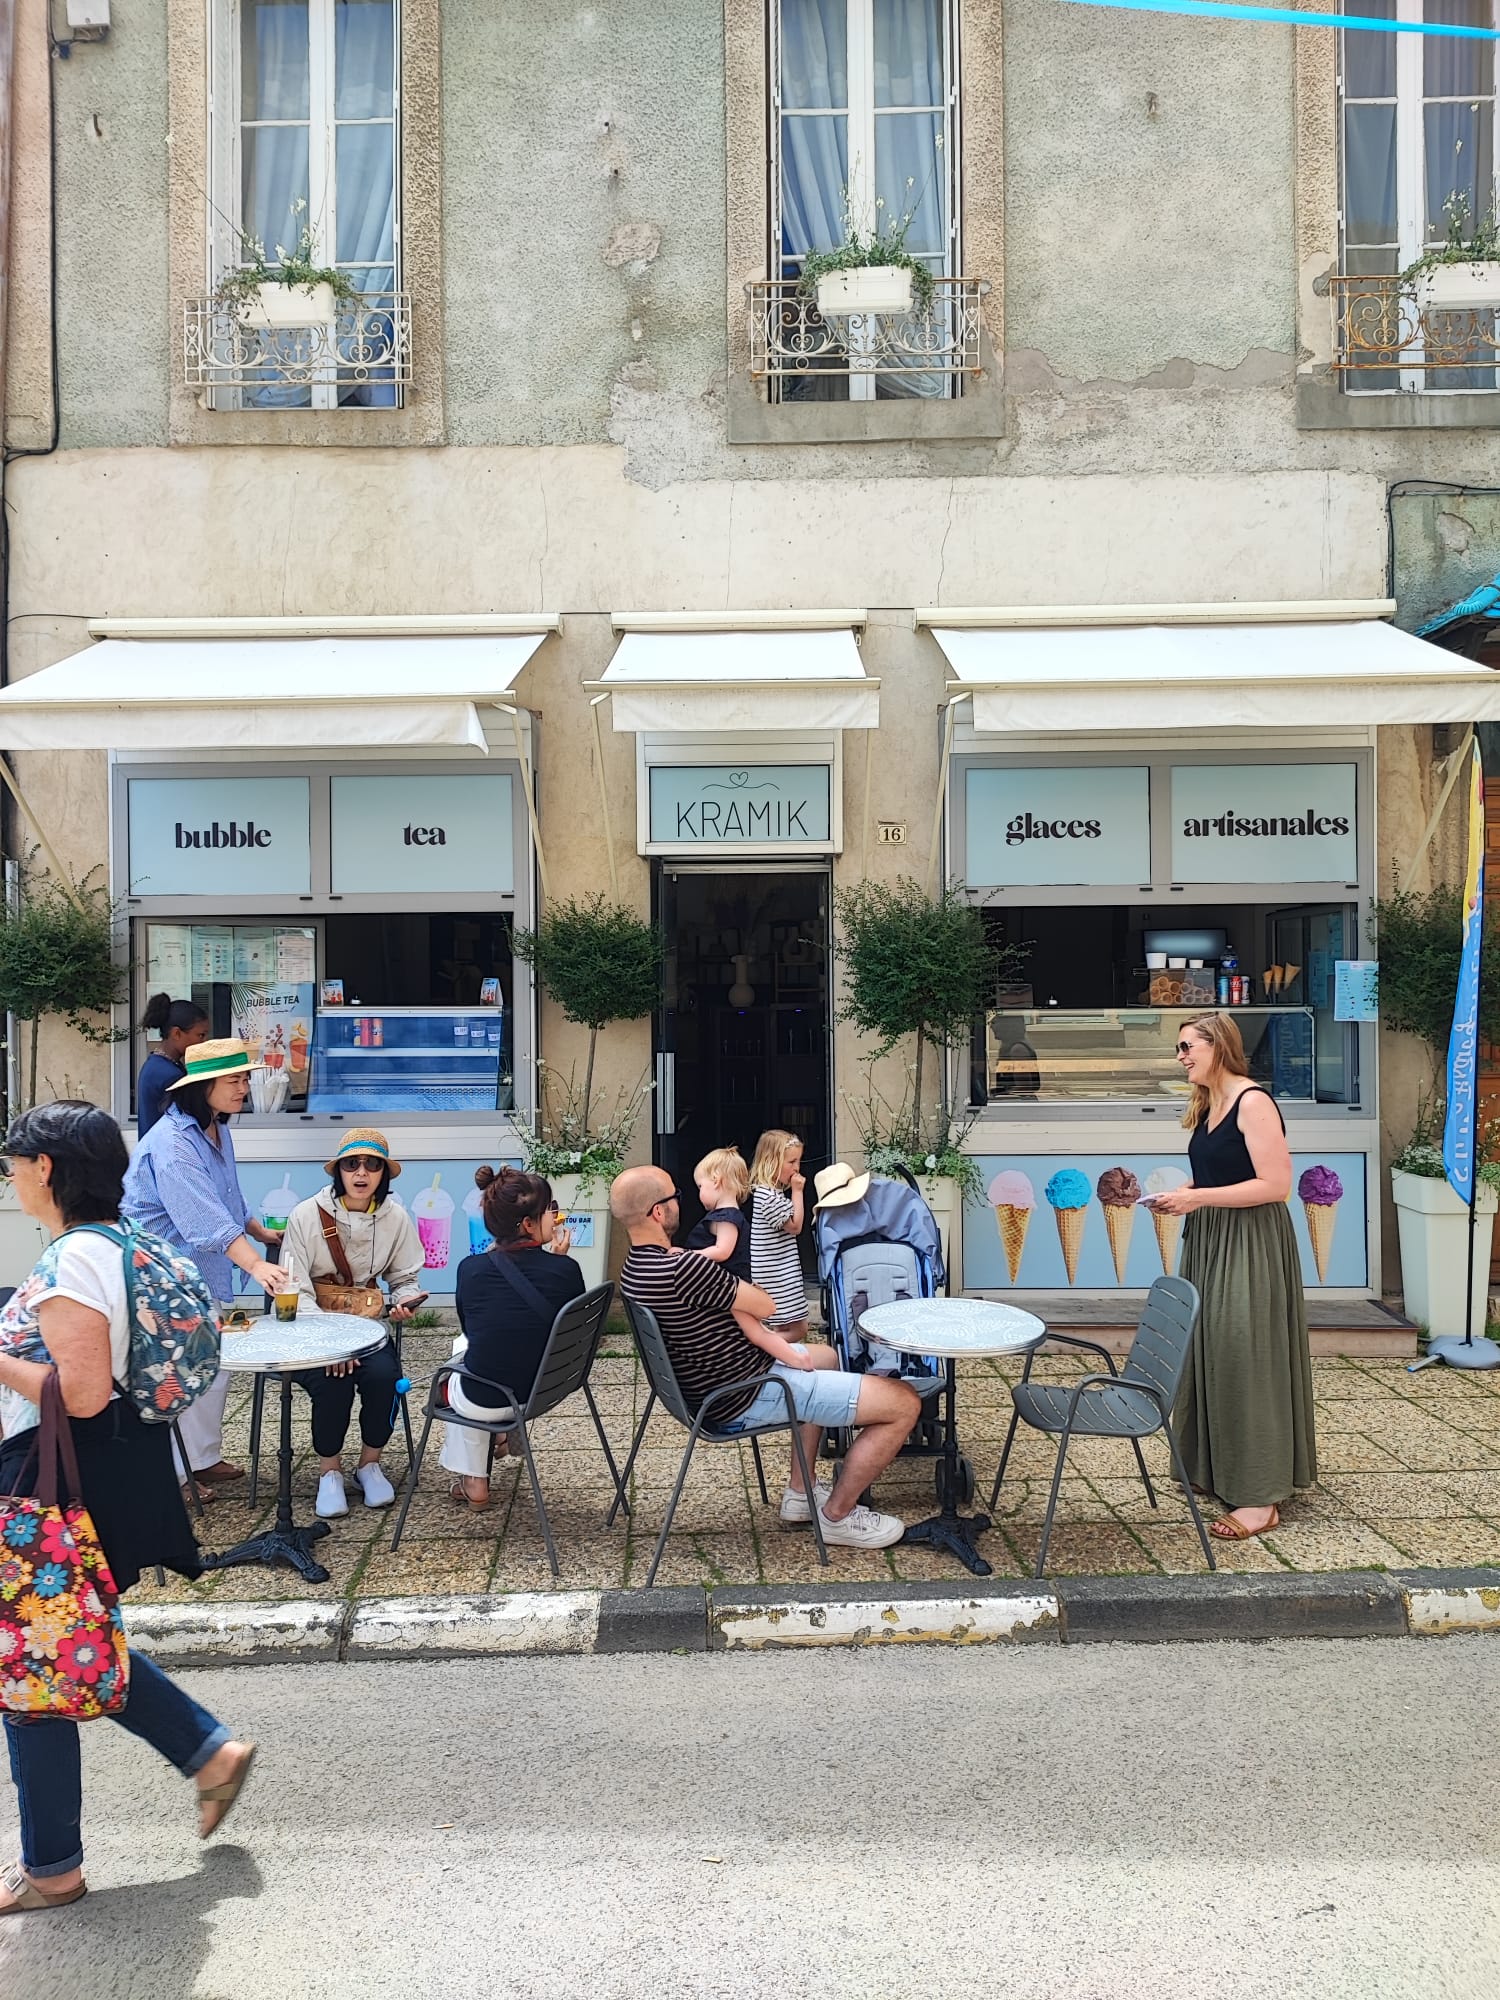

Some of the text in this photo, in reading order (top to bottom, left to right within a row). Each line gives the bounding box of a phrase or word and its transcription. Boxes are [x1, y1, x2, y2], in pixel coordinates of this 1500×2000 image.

[677, 800, 808, 838] KRAMIK
[1005, 809, 1350, 846] glaces artisanales
[175, 822, 447, 849] bubble tea
[883, 828, 901, 842] 16
[246, 995, 300, 1008] BUBBLE TEA
